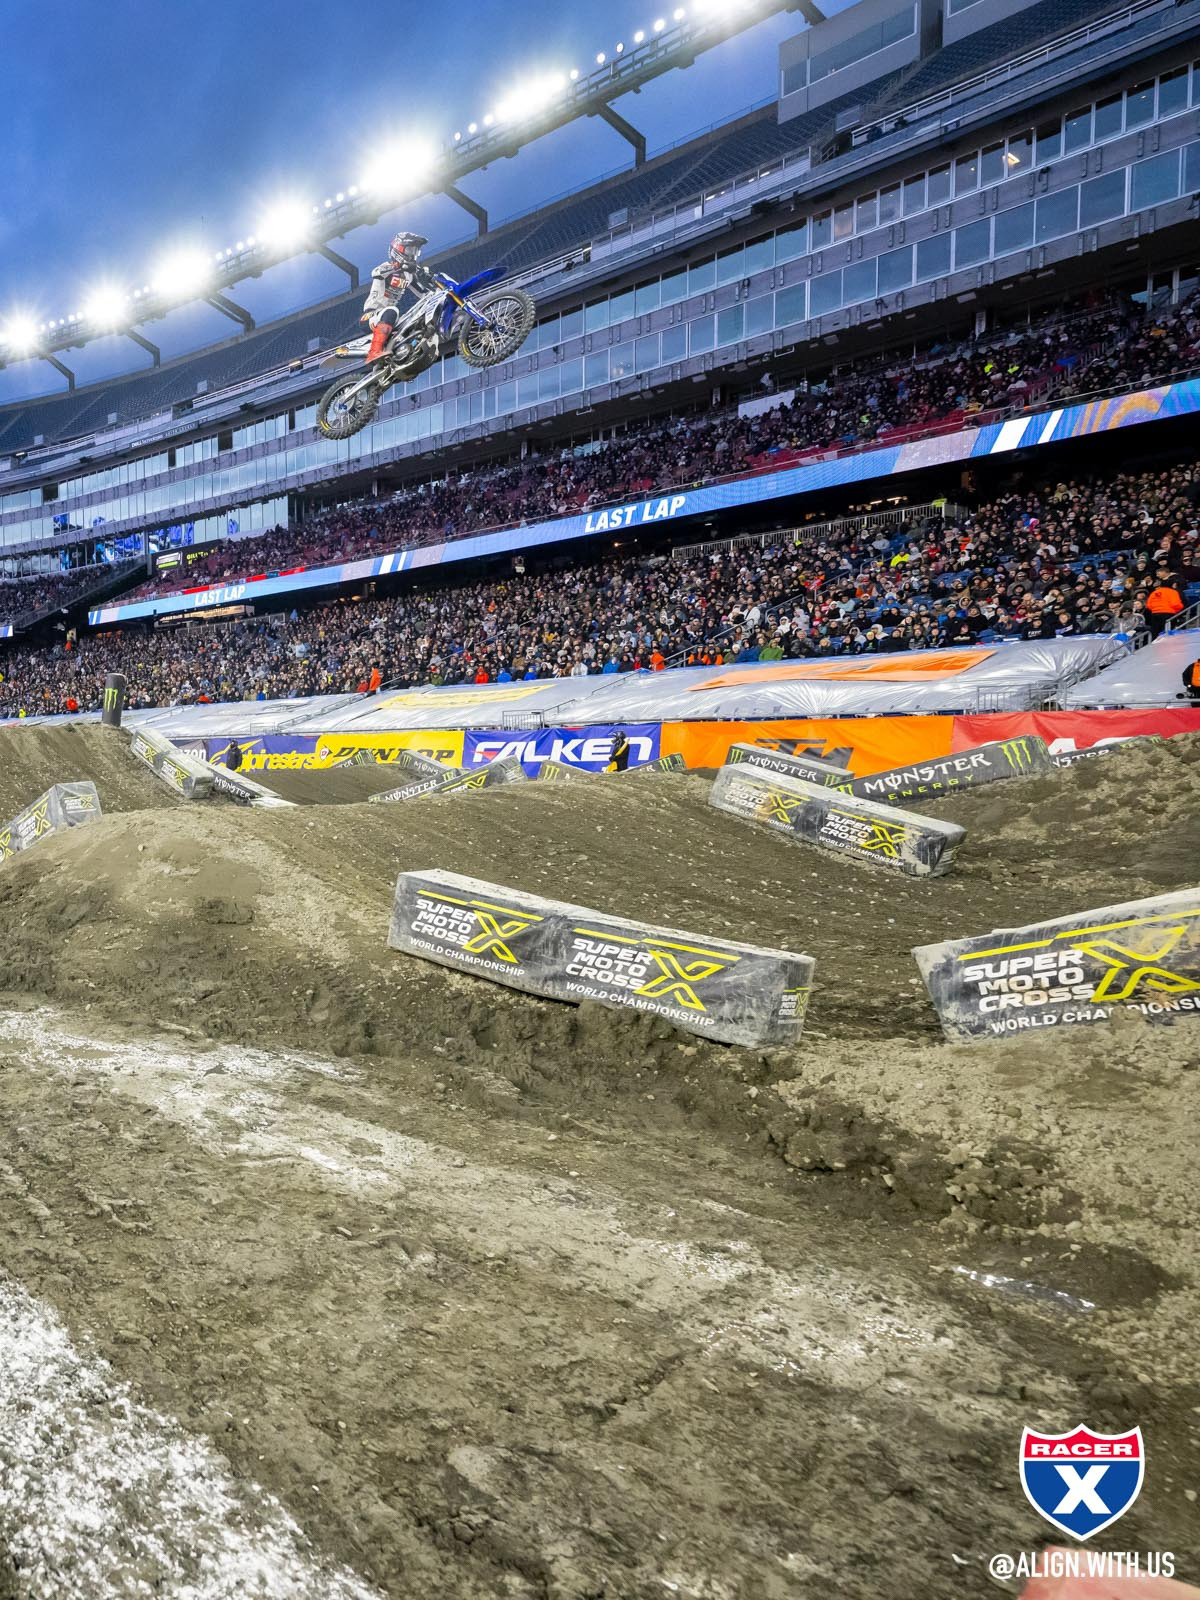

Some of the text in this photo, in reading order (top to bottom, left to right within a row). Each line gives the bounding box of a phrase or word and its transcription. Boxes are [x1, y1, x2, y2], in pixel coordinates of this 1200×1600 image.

[585, 495, 686, 533] LAST LAP
[194, 585, 247, 607] LAST LAP
[241, 749, 319, 772] lpinestars
[473, 736, 653, 764] FALKEN
[748, 755, 818, 781] MONSTER
[863, 752, 993, 795] MONSTER
[214, 776, 251, 800] MONSTER
[384, 778, 438, 801] MONSTER
[888, 774, 974, 801] ENERGY
[820, 827, 868, 845] CROSS
[825, 813, 875, 833] SUPER
[826, 821, 870, 839] MOTO
[819, 836, 846, 849] WORLD
[415, 898, 478, 924] SUPER
[418, 911, 472, 934] MOTO
[410, 920, 471, 946] CROSS
[410, 936, 526, 977] WORLD CHAMPIONSHIP
[572, 937, 653, 966] SUPER
[572, 950, 647, 977] MOTO
[566, 963, 646, 990] CROSS
[963, 949, 1086, 983] SUPER
[978, 967, 1086, 996] MOTO
[565, 981, 715, 1028] WORLD CHAMPIONSHIP
[978, 983, 1097, 1014] CROSS
[991, 1010, 1058, 1034] WORLD
